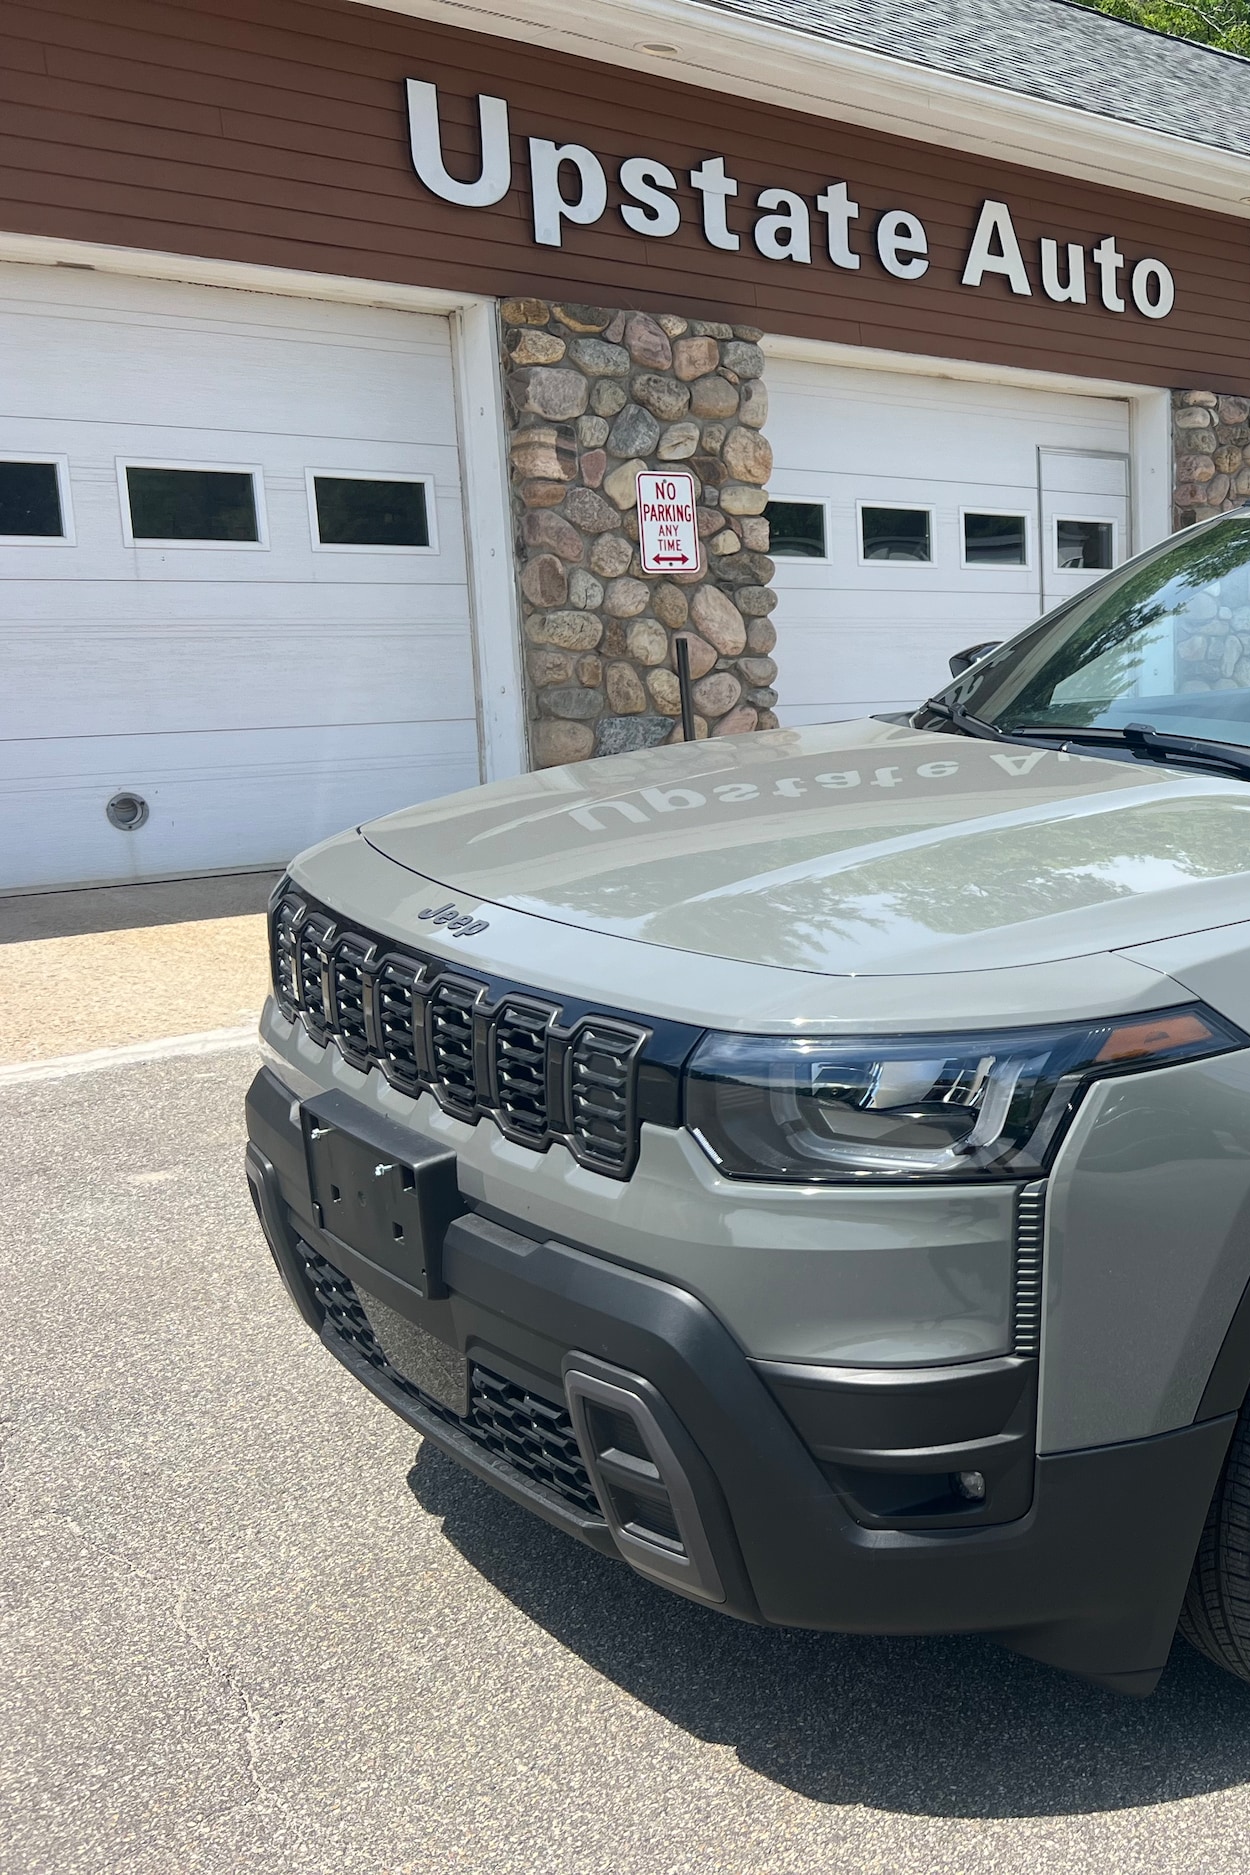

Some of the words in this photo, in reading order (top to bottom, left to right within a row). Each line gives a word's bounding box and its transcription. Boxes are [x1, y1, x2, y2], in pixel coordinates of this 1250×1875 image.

[404, 77, 930, 281] Upstate
[961, 199, 1176, 319] Auto
[655, 482, 676, 500] NO
[643, 504, 692, 522] PARKING
[658, 525, 679, 536] ANY
[657, 539, 682, 551] TIME
[418, 902, 490, 938] Jeep
